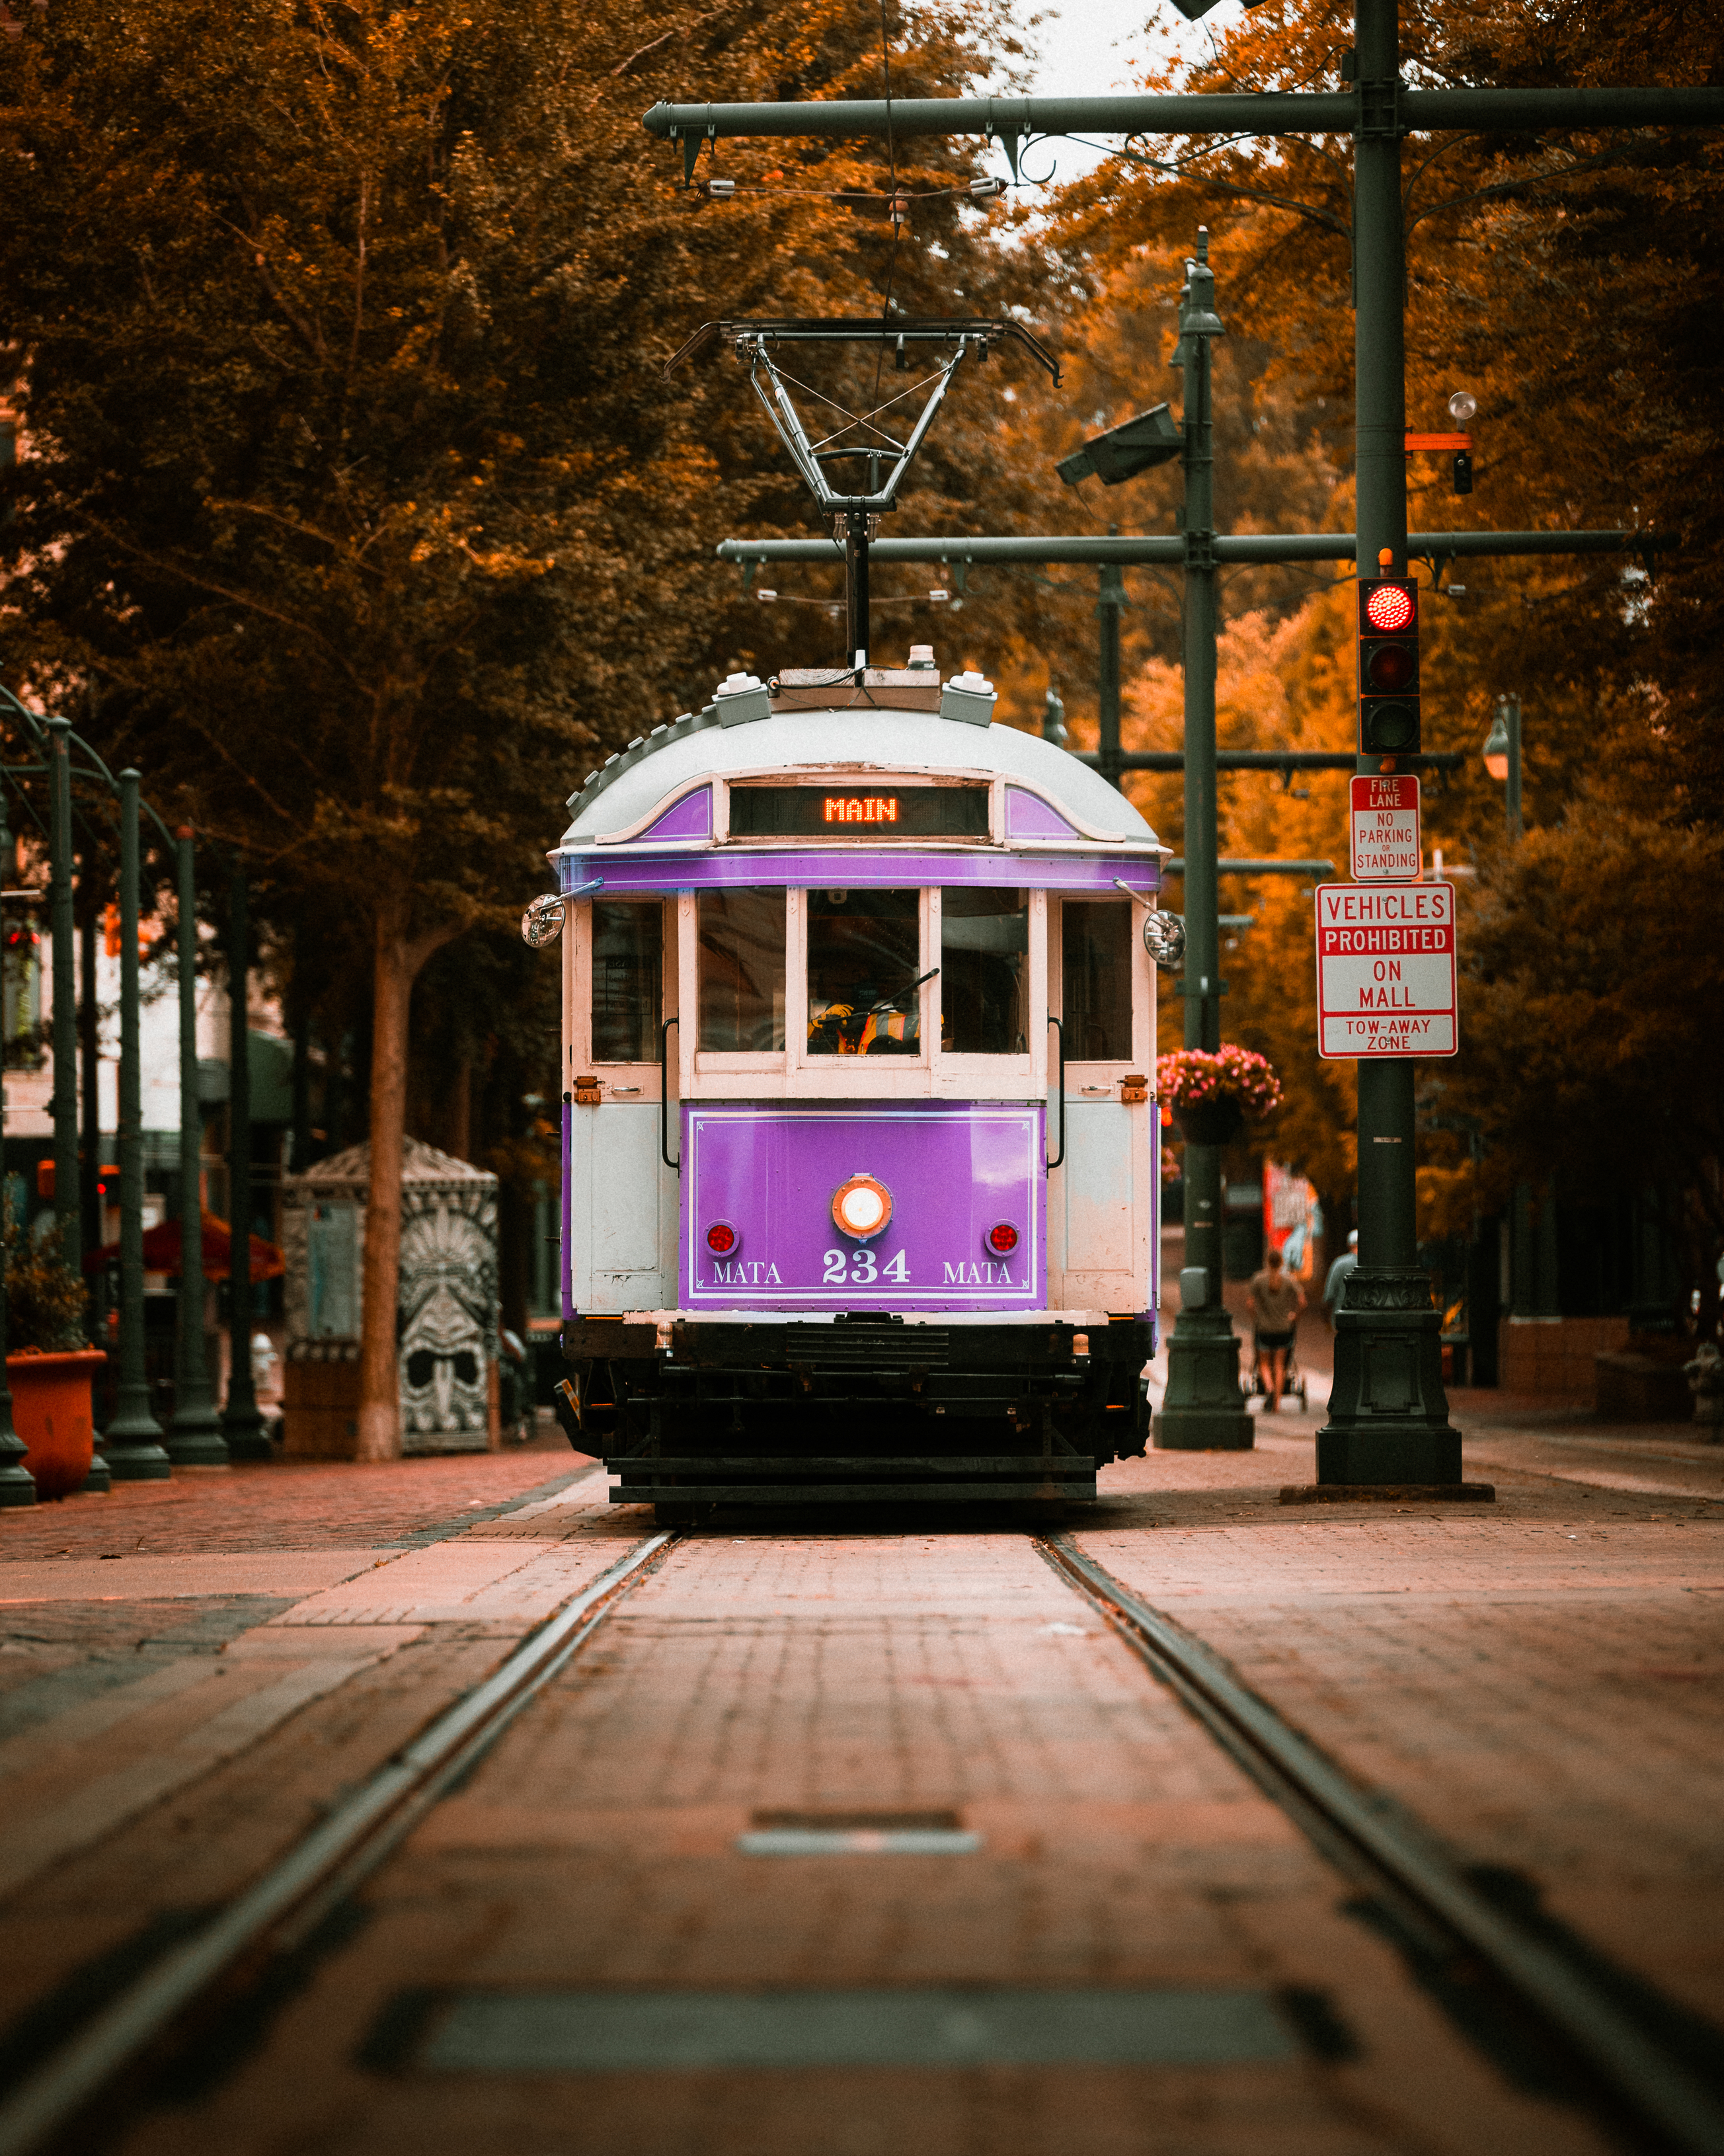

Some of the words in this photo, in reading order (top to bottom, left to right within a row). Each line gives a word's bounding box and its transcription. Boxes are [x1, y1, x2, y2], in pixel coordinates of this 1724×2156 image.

[1371, 779, 1399, 793] FIRE
[825, 798, 897, 821] MAIN
[1370, 793, 1402, 807] LANE
[1377, 813, 1393, 826] NO
[1359, 828, 1412, 844] PARKING
[1357, 853, 1416, 868] STANDING
[1327, 895, 1444, 920] VEHICLES
[1325, 929, 1446, 951] PROHIBITED
[1373, 960, 1401, 982] ON
[1359, 986, 1416, 1008] MALL
[1346, 1019, 1430, 1035] TOW-AWAY
[1367, 1035, 1411, 1050] ZONE
[713, 1261, 783, 1284] MATA
[822, 1249, 911, 1284] 234
[942, 1261, 1013, 1284] MATA
